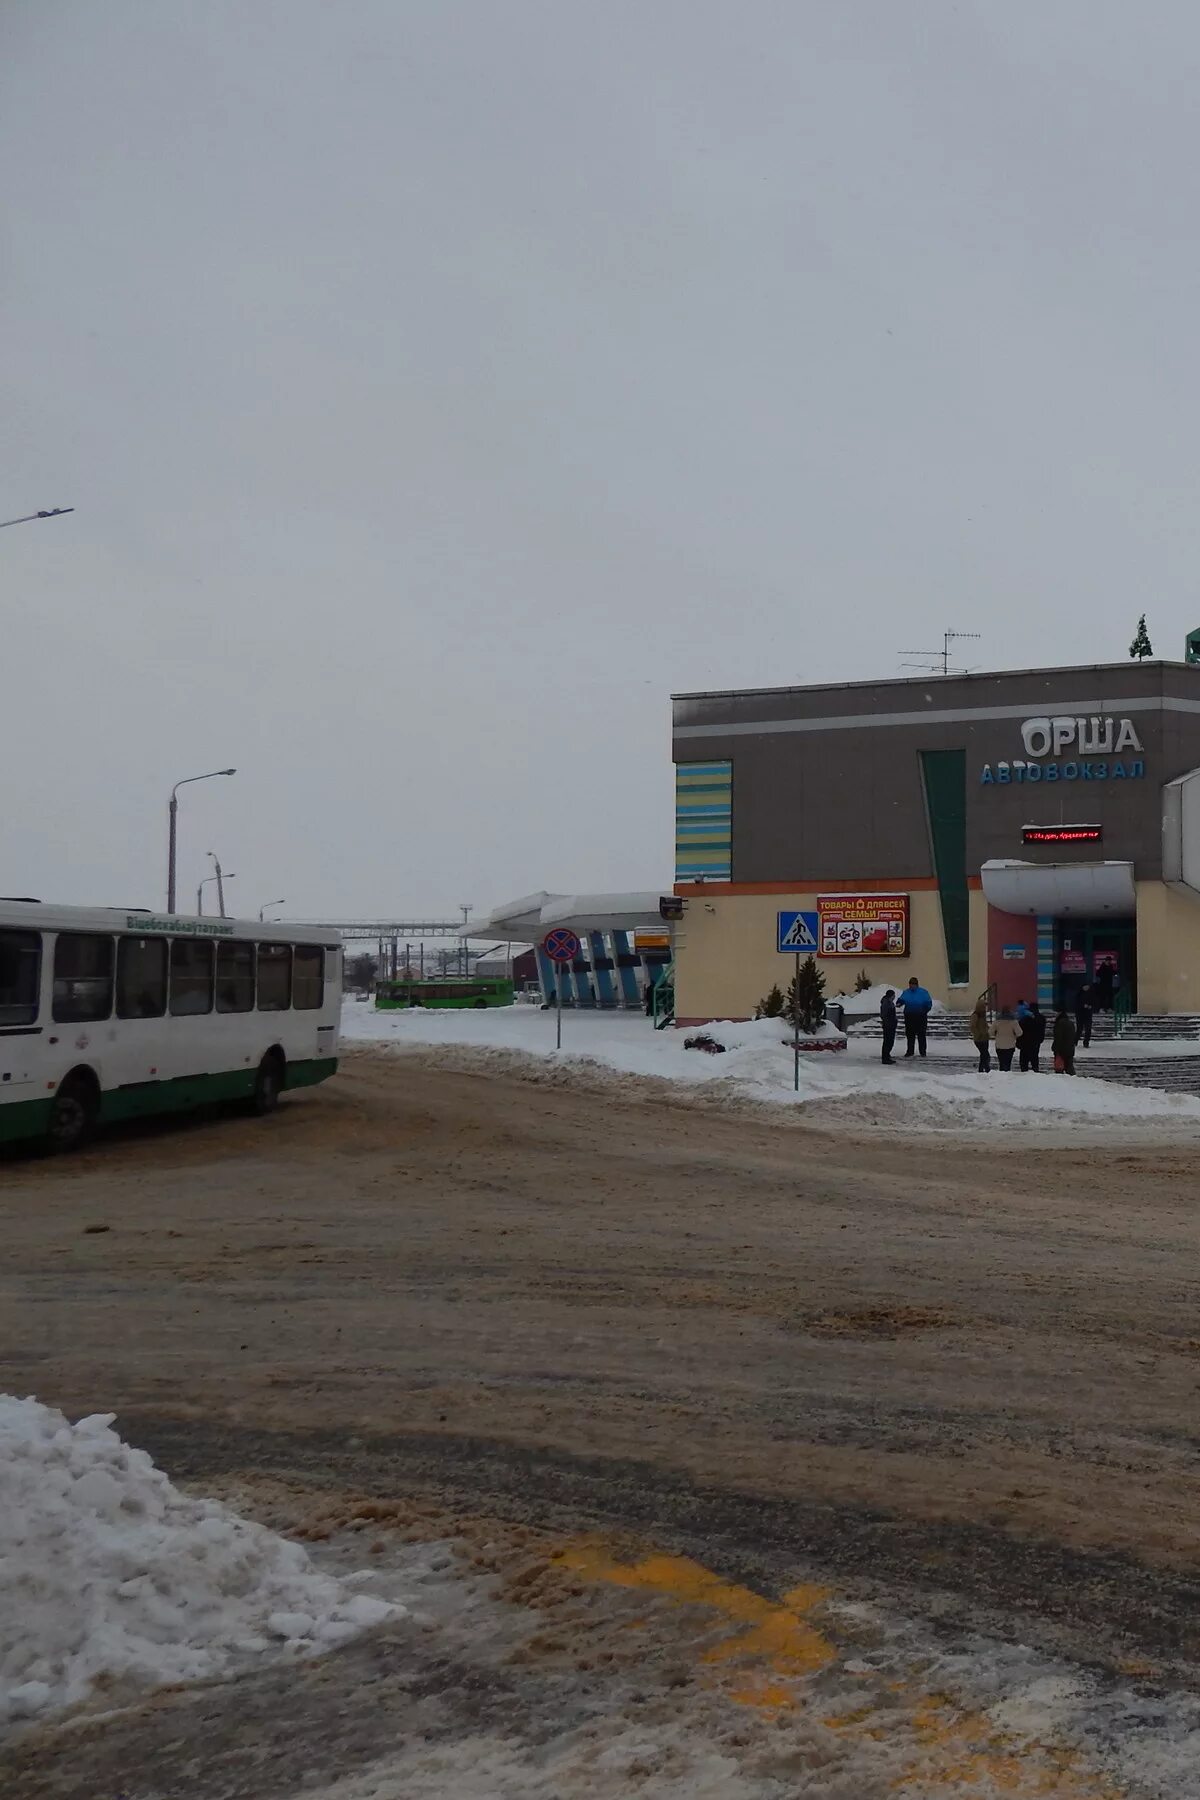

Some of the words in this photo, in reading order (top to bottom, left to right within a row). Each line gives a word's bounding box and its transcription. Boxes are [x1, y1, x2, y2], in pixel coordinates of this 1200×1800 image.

[1021, 717, 1144, 757] ОРША
[981, 761, 1144, 784] АВТОВОКЗАЛ
[820, 901, 855, 910] ТОВАРЫ
[844, 910, 877, 918] СЕМЬИ
